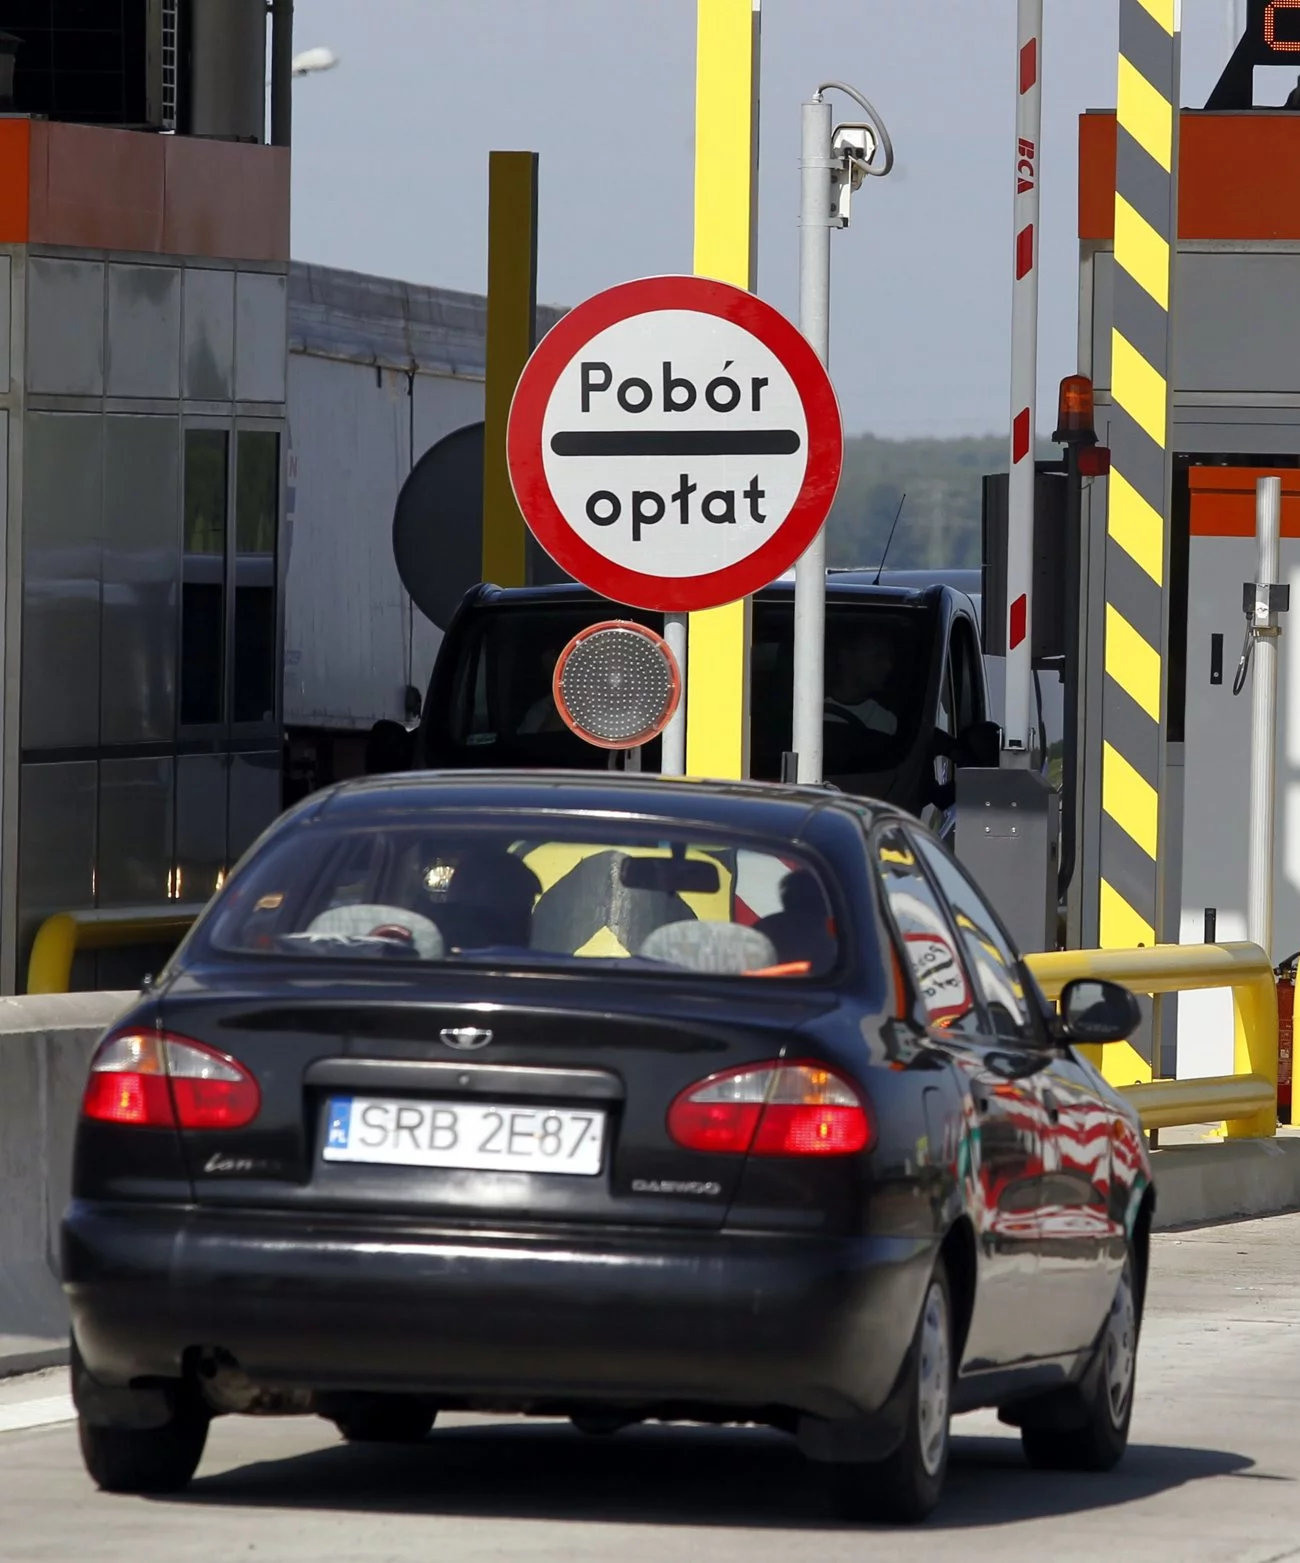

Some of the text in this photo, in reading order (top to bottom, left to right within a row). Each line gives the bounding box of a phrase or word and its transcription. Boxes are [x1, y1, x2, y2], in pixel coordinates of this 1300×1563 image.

[1017, 137, 1035, 195] BCA
[581, 360, 769, 414] Pobór
[585, 473, 767, 542] opłat
[358, 1104, 595, 1159] SRB 2E87
